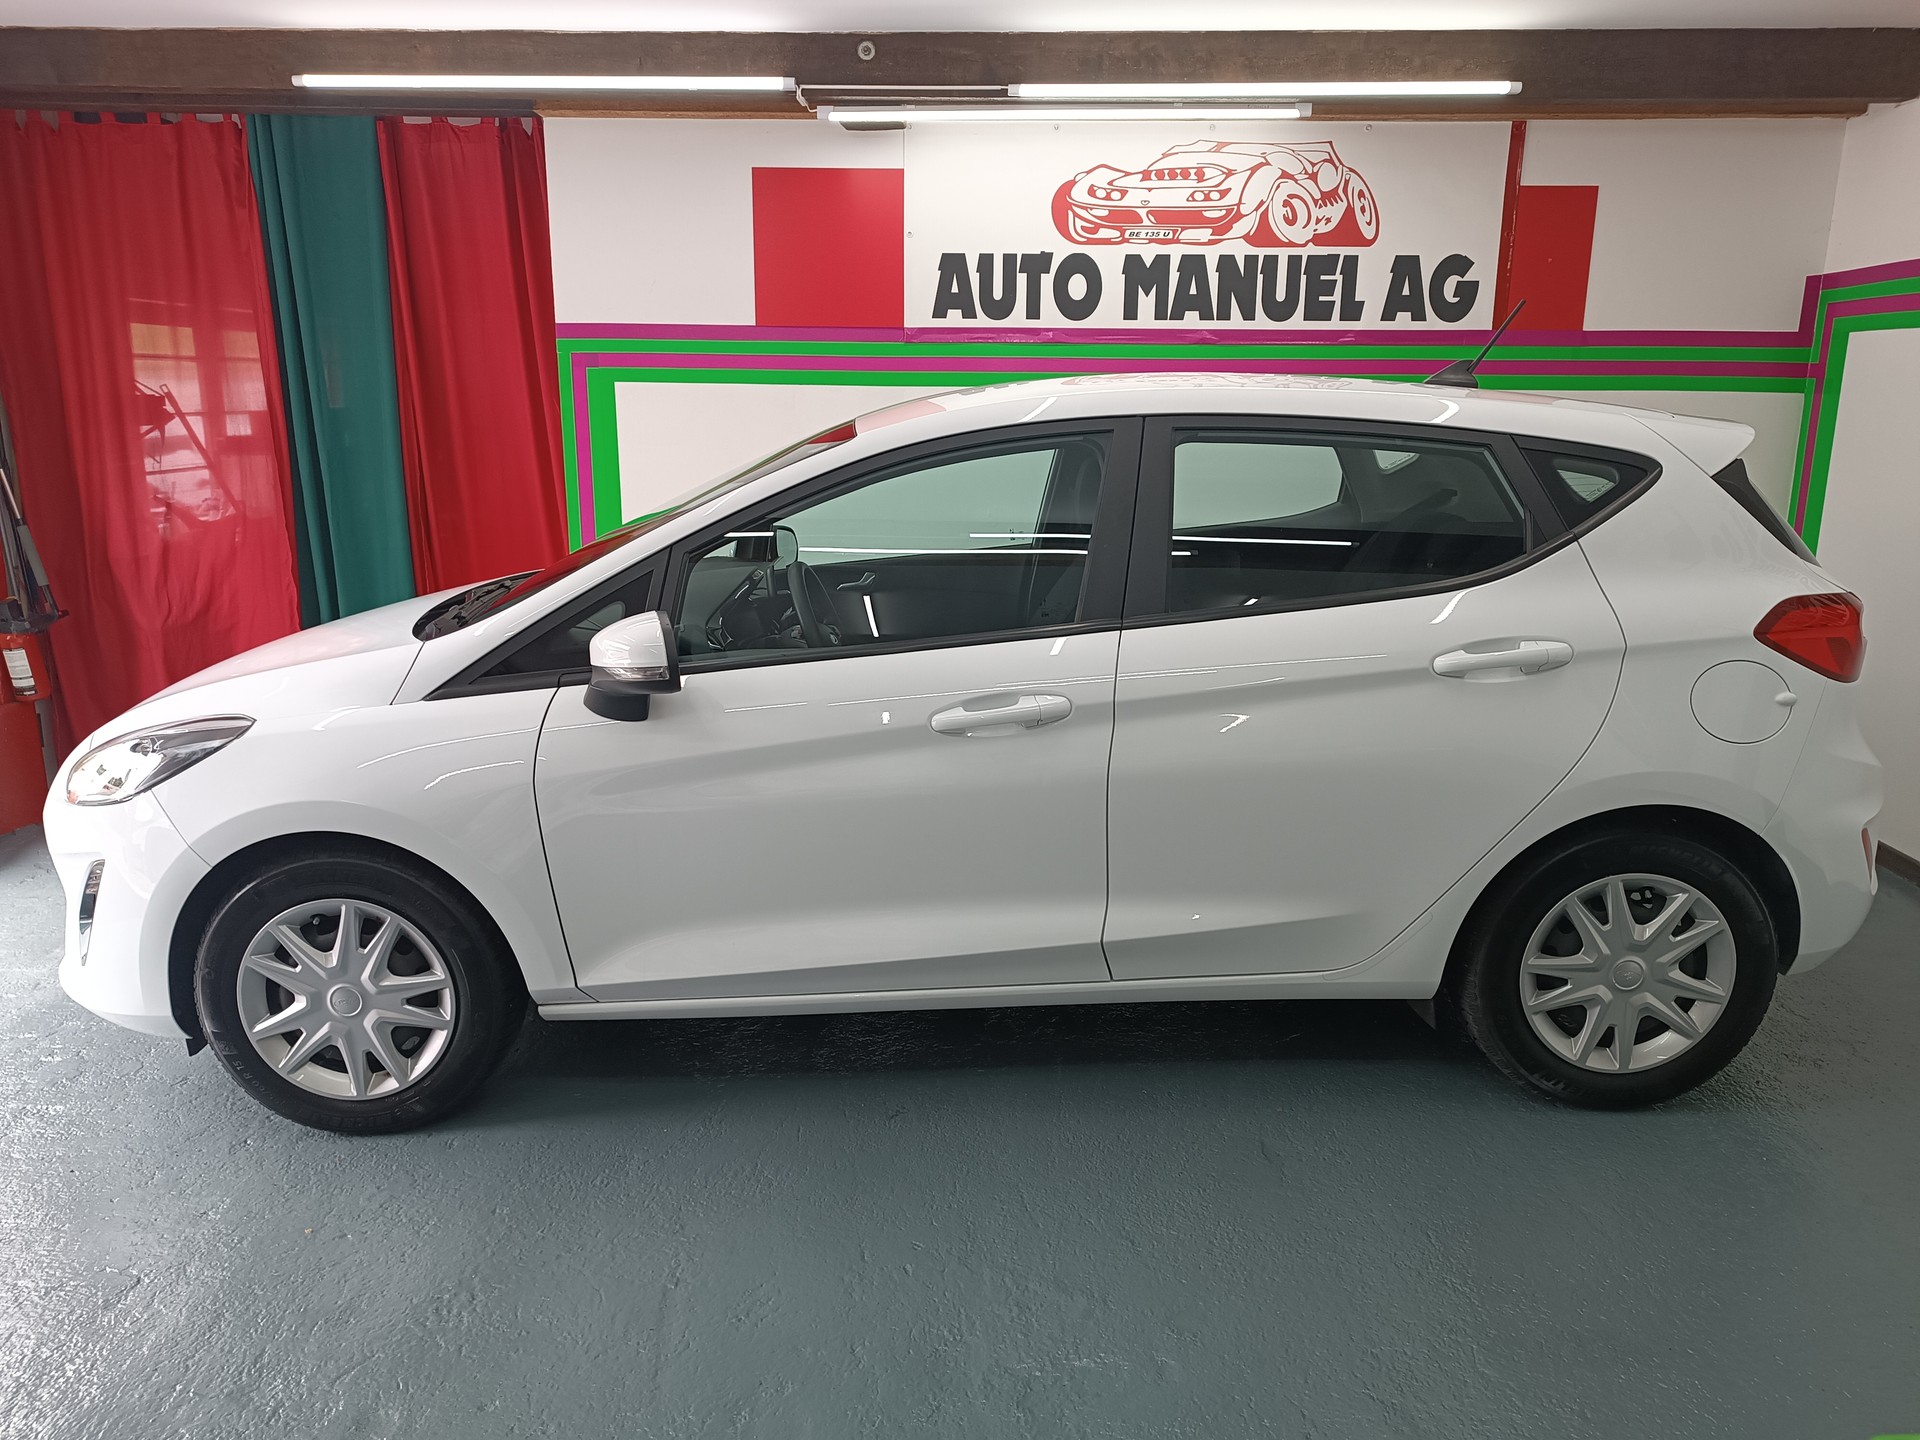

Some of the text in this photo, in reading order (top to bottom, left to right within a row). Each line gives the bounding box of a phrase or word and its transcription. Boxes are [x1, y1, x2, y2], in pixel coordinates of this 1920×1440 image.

[932, 251, 1480, 323] AUTO MANUEL AG
